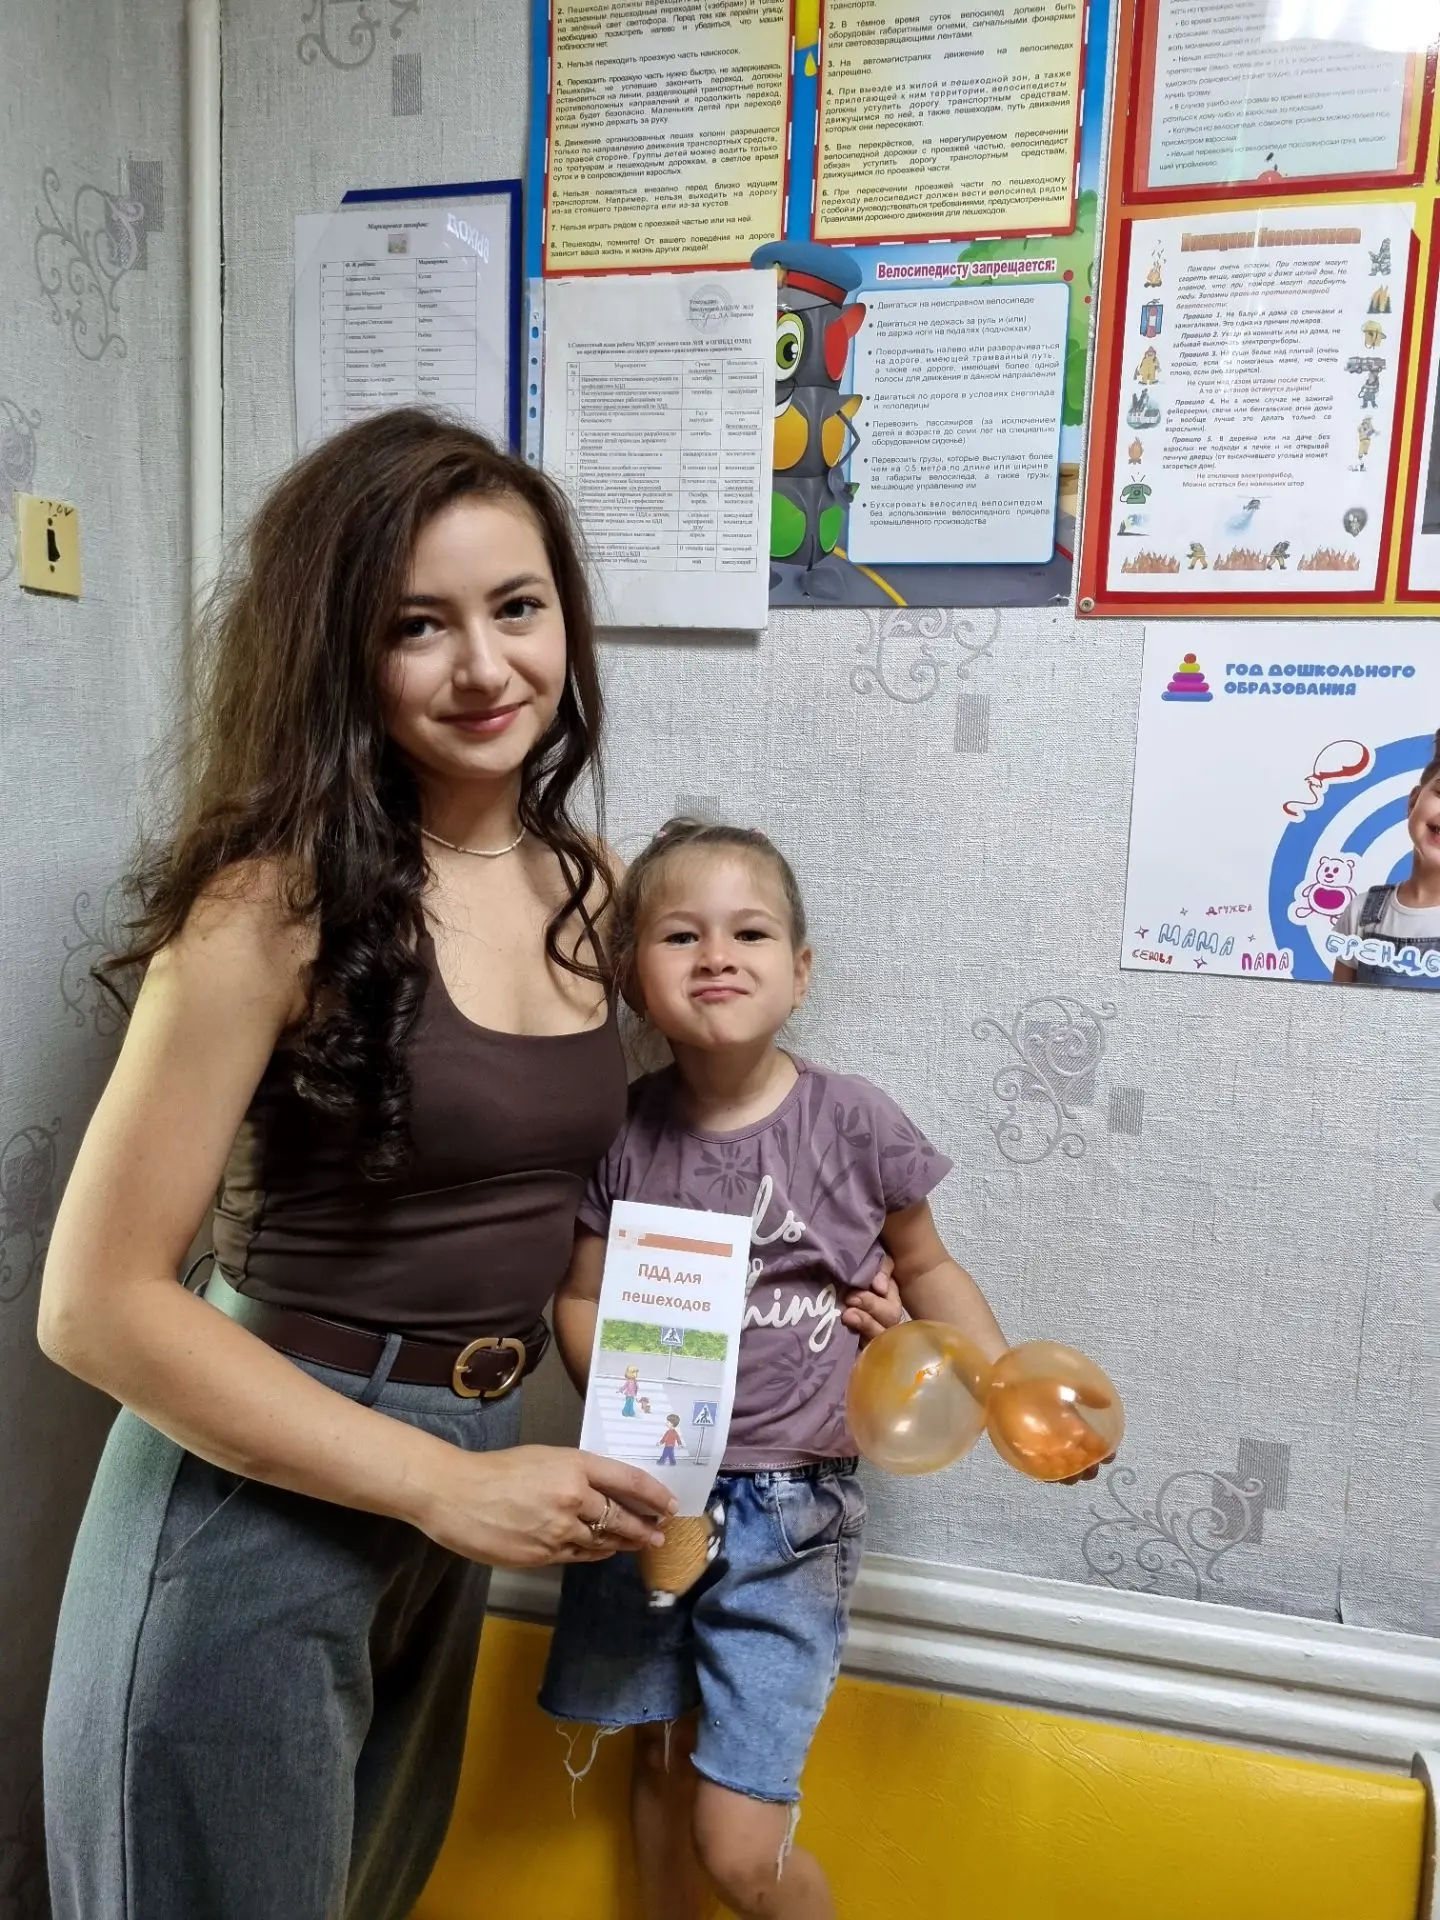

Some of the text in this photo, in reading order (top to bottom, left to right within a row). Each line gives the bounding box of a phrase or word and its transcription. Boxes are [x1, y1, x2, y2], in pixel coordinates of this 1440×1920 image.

[878, 260, 1055, 279] Велосипедисту запрещается:
[1225, 664, 1416, 678] ГОД ДОШКОЛЬНОГО
[1224, 682, 1356, 696] ОБРАЗОВАНИЯ
[1158, 923, 1235, 956] МАМА
[1132, 949, 1173, 965] СЕМЬЯ
[1241, 952, 1290, 971] ПАПА
[638, 1263, 702, 1285] ПДД для
[622, 1291, 711, 1312] пешеходов
